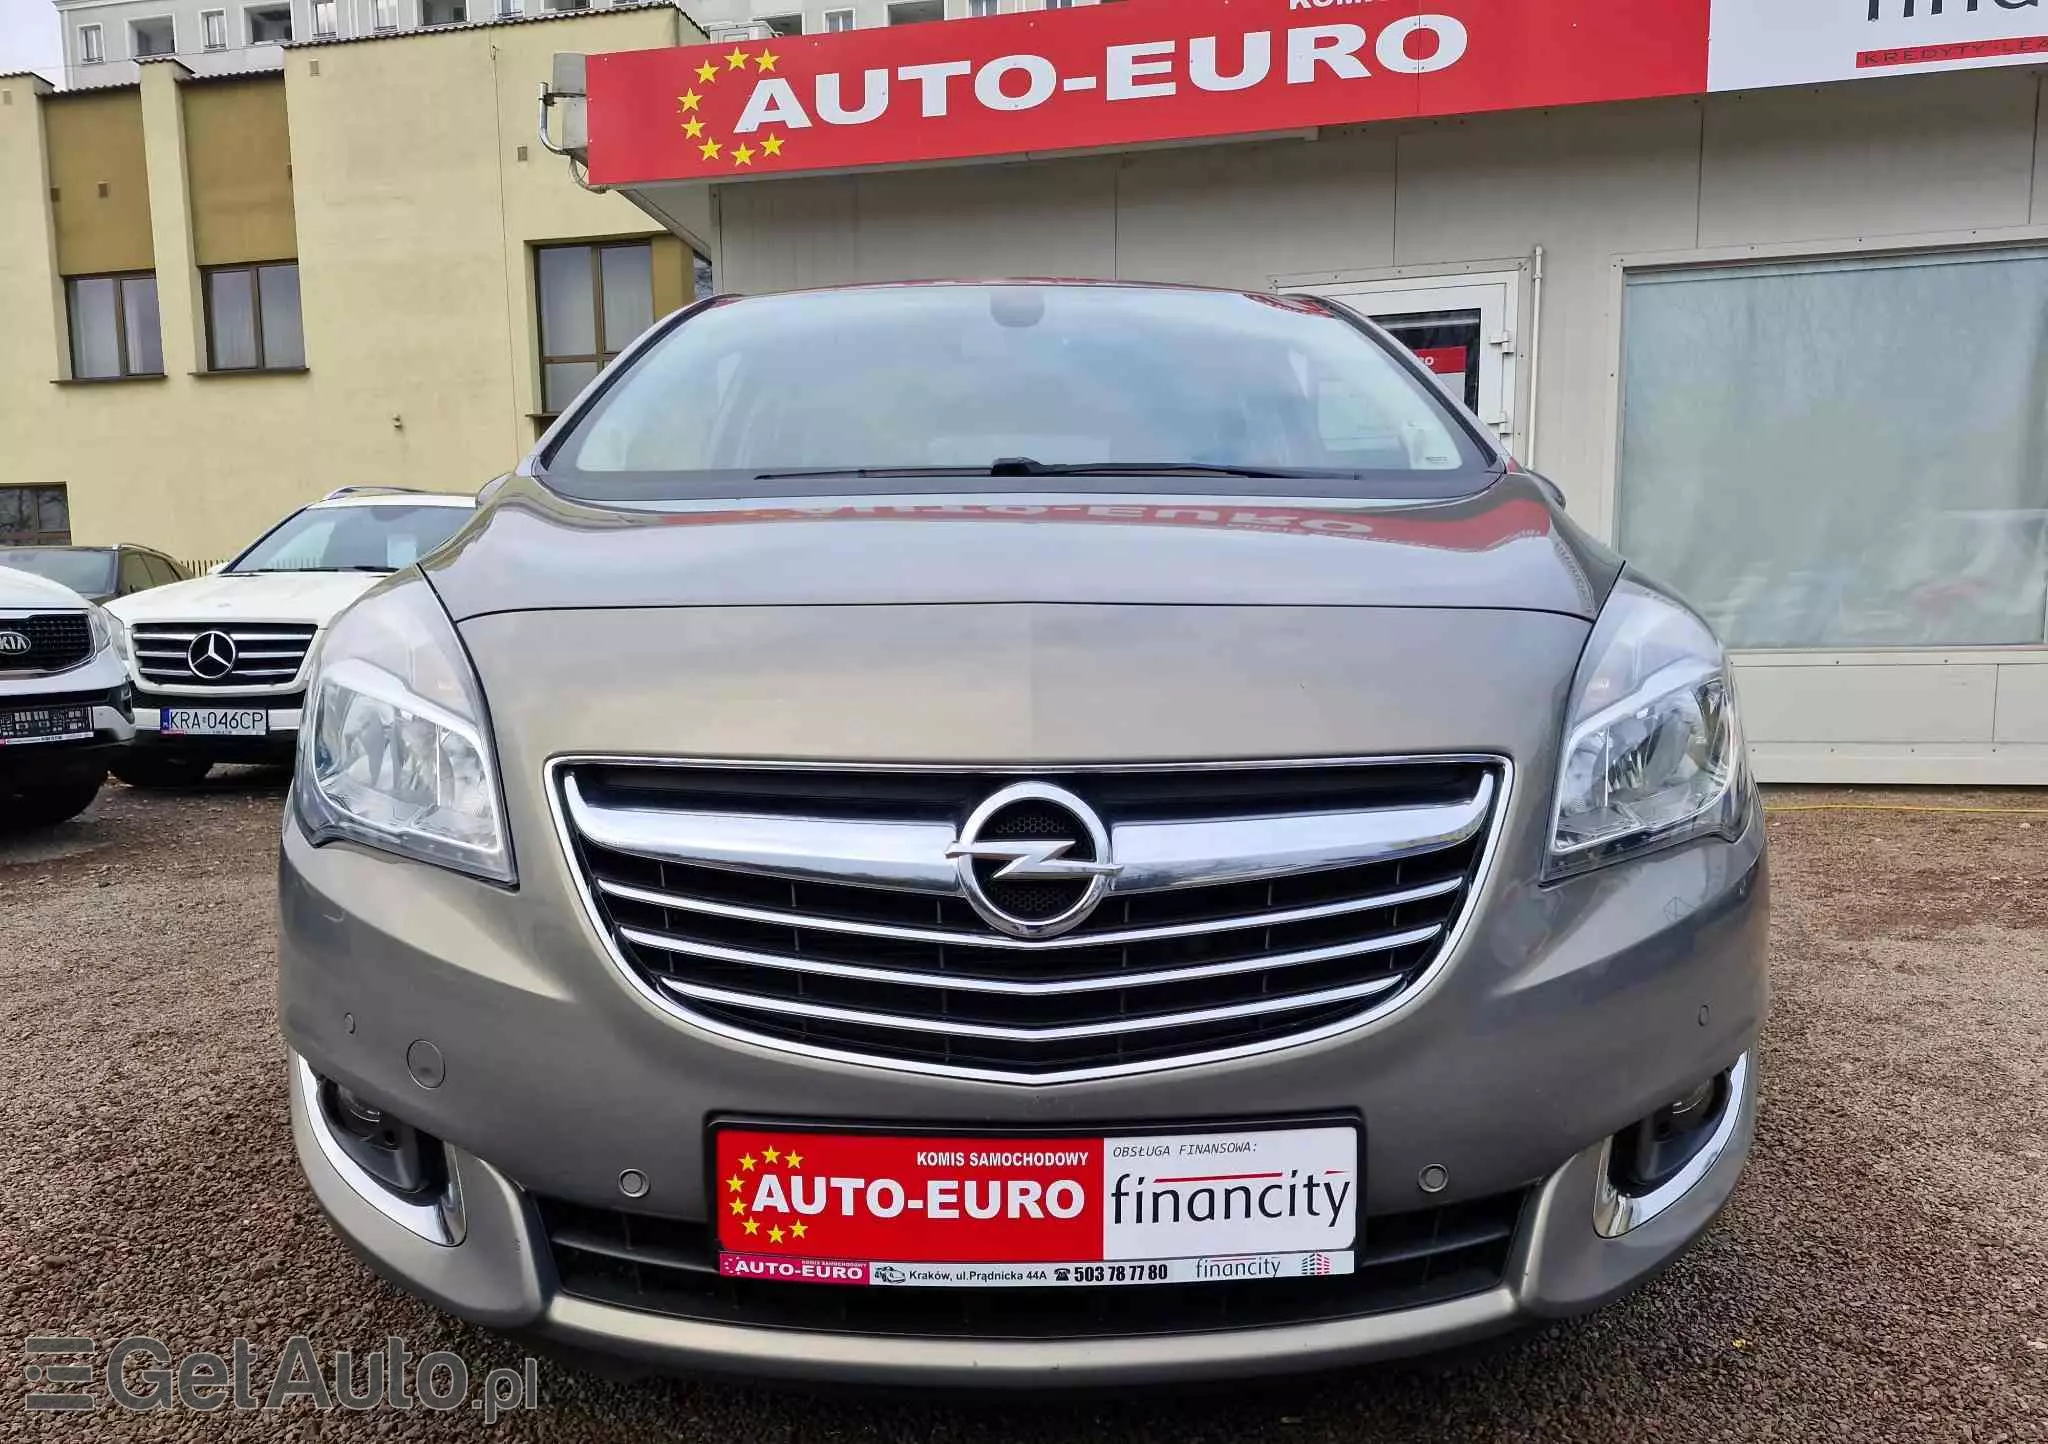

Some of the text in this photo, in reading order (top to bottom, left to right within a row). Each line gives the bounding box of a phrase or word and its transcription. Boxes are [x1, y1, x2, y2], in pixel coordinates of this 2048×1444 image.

[733, 13, 1468, 135] AUTO-EURO
[170, 711, 264, 729] KRA 046CP
[916, 1151, 1089, 1167] KOMIS SAMOCHODOWY
[1112, 1142, 1258, 1158] OBSŁUGA FINANSOWA:
[751, 1173, 1085, 1220] AUTO-EURO
[1110, 1168, 1351, 1228] financity
[735, 1259, 863, 1280] AUTO-EURO
[909, 1270, 953, 1282] Kraków,
[1026, 1271, 1048, 1281] 44A
[1074, 1266, 1105, 1282] 503
[1108, 1266, 1126, 1282] 78
[1128, 1265, 1145, 1281] 77
[1148, 1264, 1168, 1280] 80
[1196, 1256, 1281, 1280] financity
